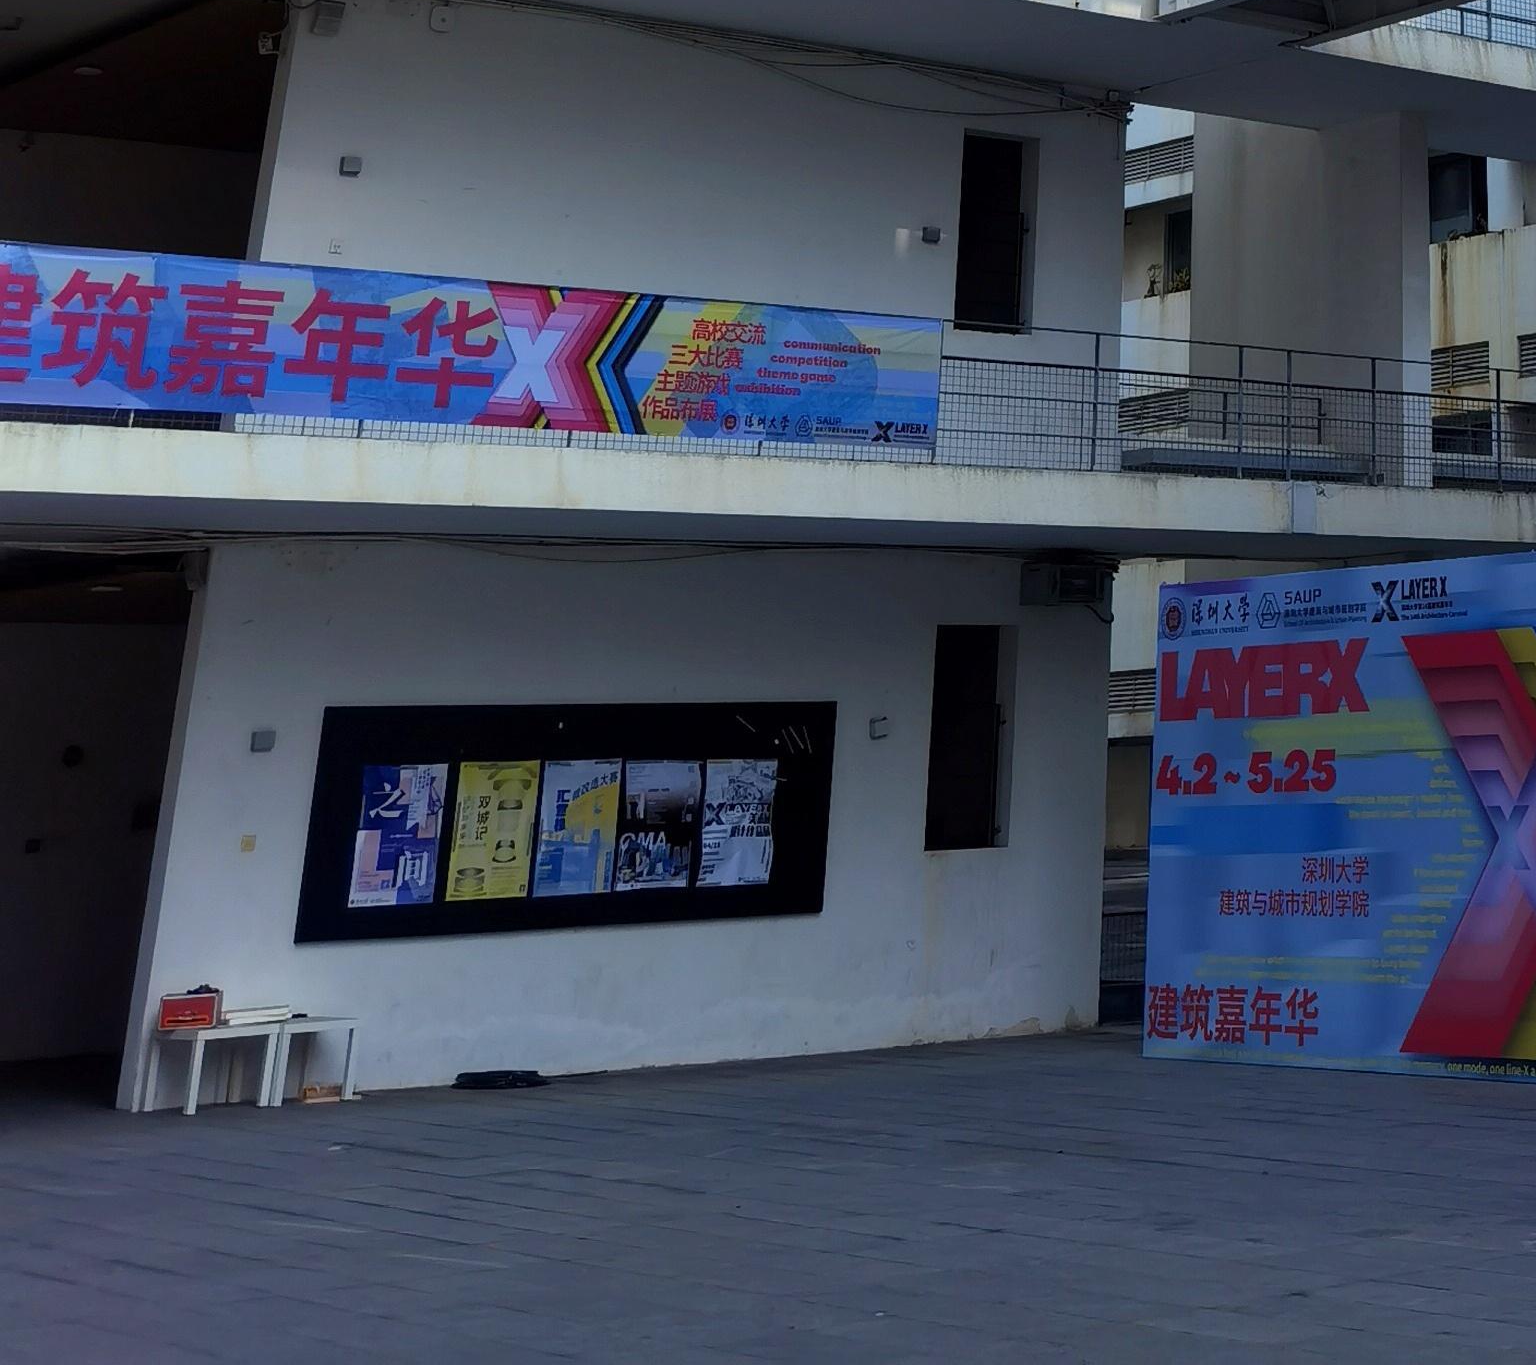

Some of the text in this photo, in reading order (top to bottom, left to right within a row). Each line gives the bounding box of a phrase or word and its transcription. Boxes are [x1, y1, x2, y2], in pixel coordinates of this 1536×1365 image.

[692, 318, 767, 345] 高校交流
[669, 344, 744, 370] 三大比赛
[783, 340, 881, 356] communication
[770, 354, 848, 369] competition
[655, 370, 730, 396] 主题游戏
[642, 395, 719, 422] 作品布展
[1284, 588, 1322, 606] SAUP
[1401, 577, 1438, 600] LAYER
[1159, 637, 1370, 722] LAYERX
[1302, 856, 1370, 884] 深圳大学
[1219, 889, 1370, 918] 建筑与城市规划学院
[1147, 983, 1320, 1047] 建筑嘉年华
